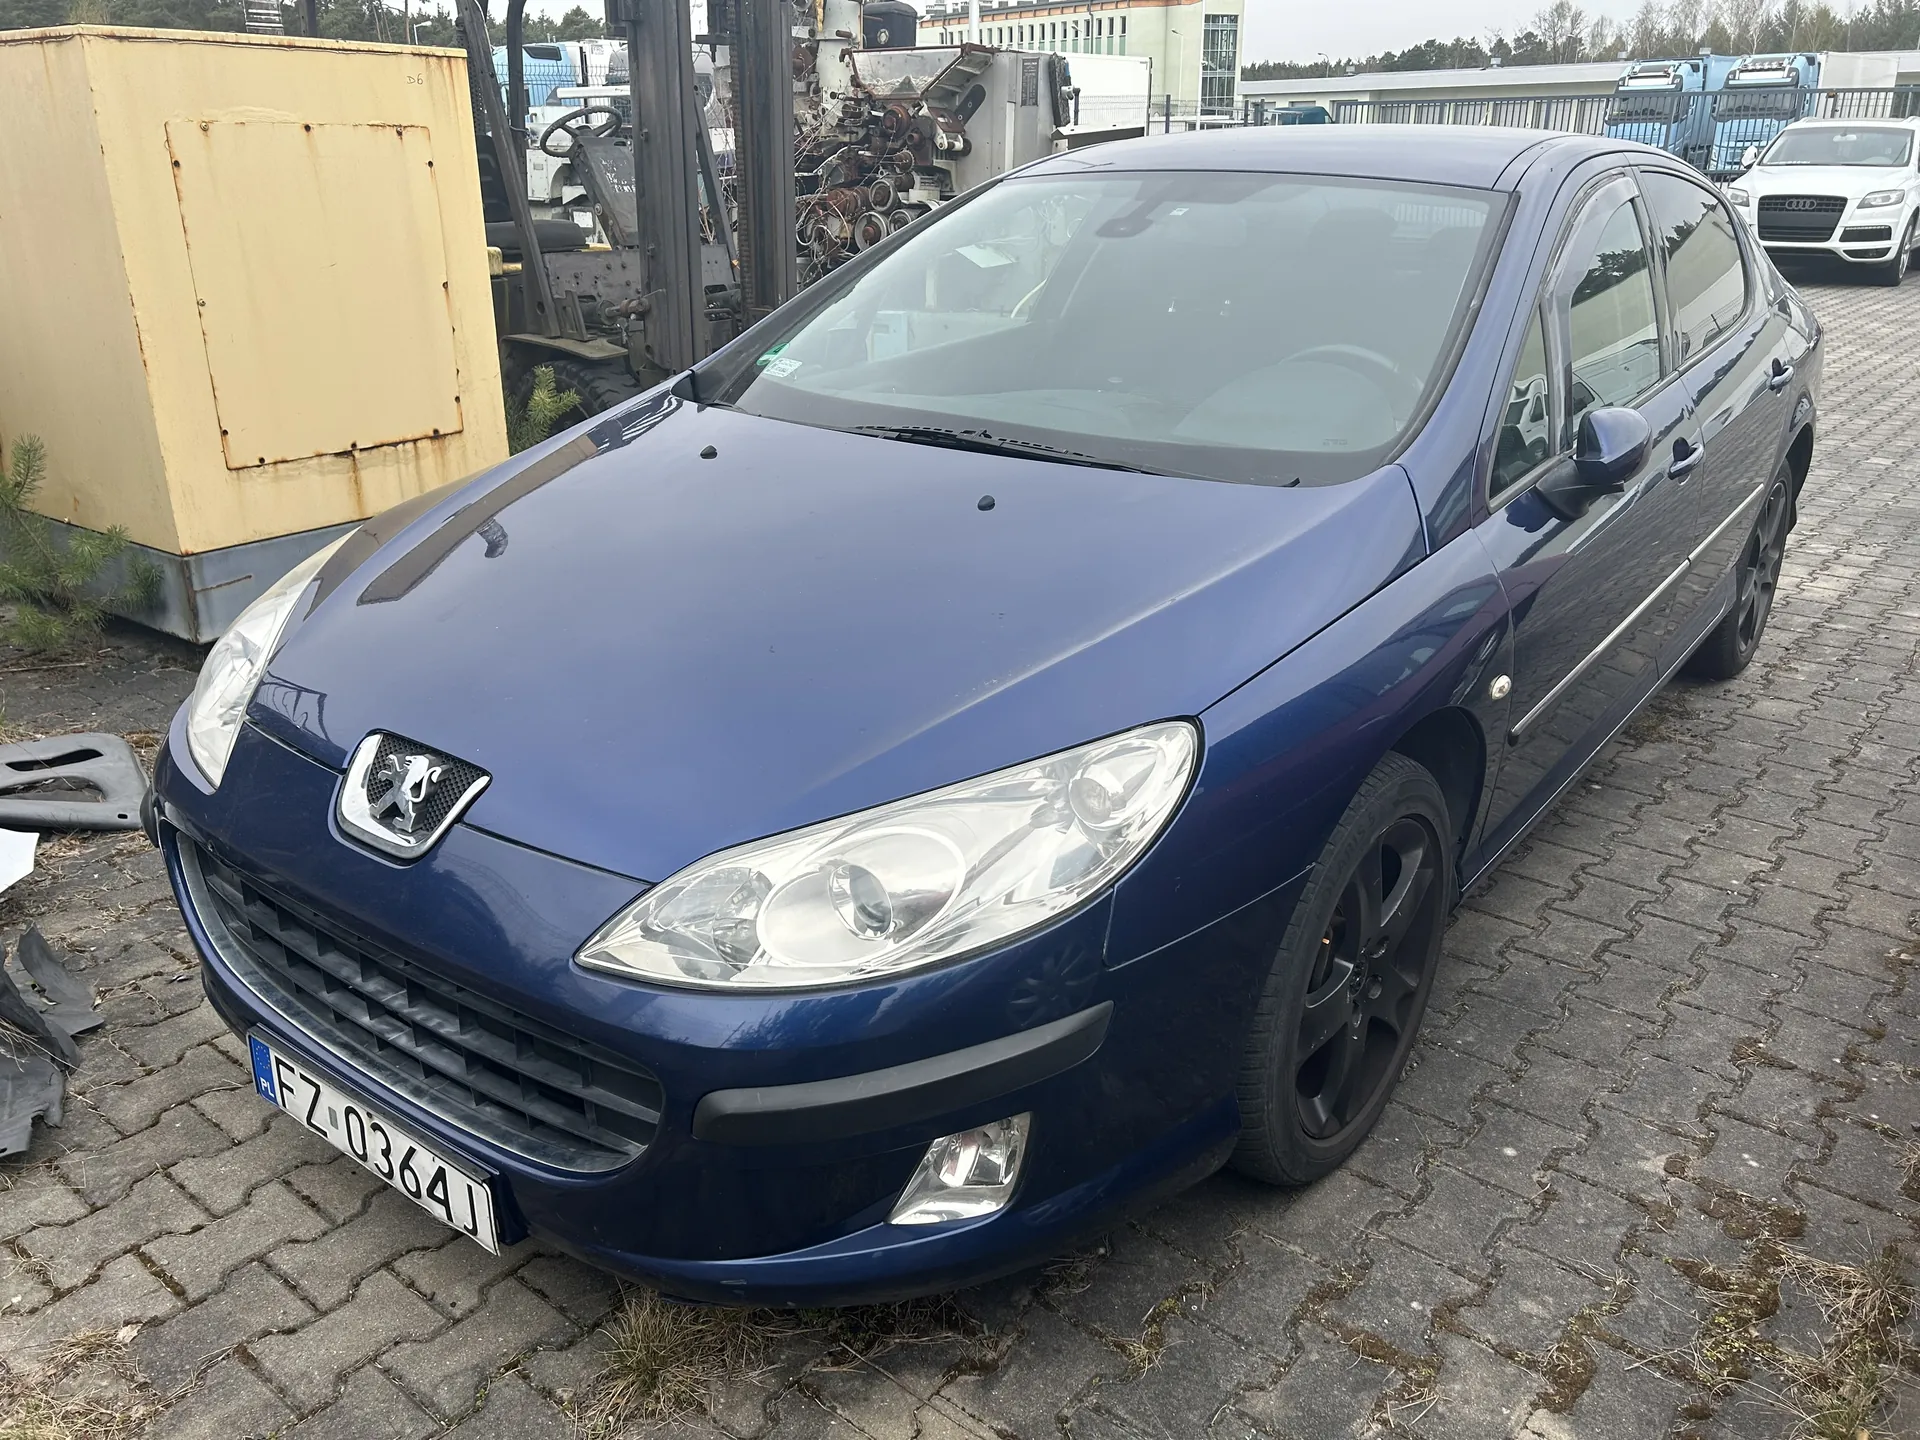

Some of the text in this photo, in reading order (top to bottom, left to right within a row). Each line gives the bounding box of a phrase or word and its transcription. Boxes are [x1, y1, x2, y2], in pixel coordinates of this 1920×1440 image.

[406, 72, 423, 85] D6
[260, 1076, 275, 1098] PL
[274, 1054, 478, 1236] FZ 0364J
